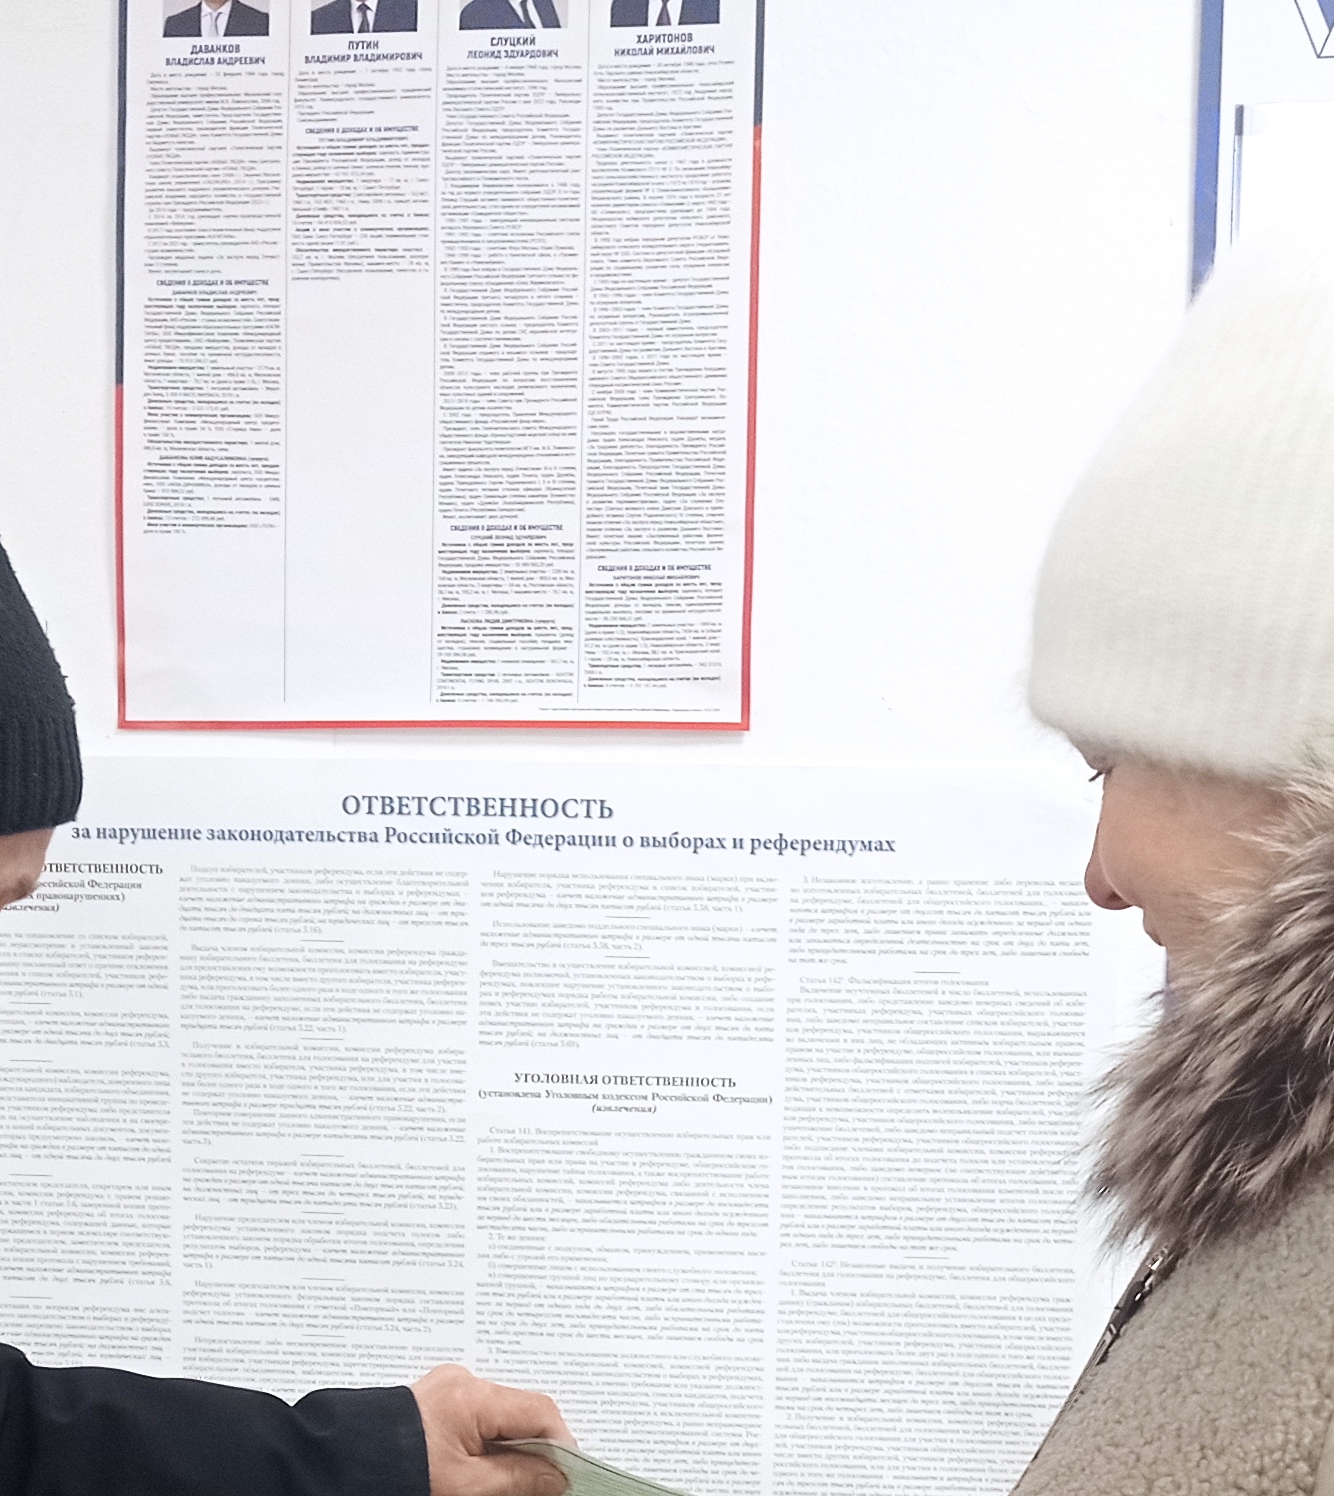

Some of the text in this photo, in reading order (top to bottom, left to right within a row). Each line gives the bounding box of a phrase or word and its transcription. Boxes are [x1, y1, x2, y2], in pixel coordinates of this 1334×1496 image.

[490, 36, 536, 48] СЛУЦКИЙ
[636, 32, 694, 44] ХАРИТОНОВ
[190, 44, 241, 56] ДАВАНКОВ
[347, 40, 379, 51] ПУТИН
[614, 45, 715, 57] НИКОЛАЙ МИХАЙЛОВИЧ
[304, 52, 423, 65] ВЛАДИМИР ВЛАДИМИРОВИЧ
[466, 49, 559, 60] ЛЕОНИД ЭДУАРДОВИЧ
[165, 56, 266, 67] ВЛАДИСЛАВ АНДРЕЕВИЧ
[342, 794, 614, 819] ОТВЕТСТВЕННОСТЬ
[71, 826, 896, 857] за нарушение законодательства Российской Федерации о выборах и референдумах
[35, 878, 142, 891] оссийской Федерации
[35, 892, 126, 903] правонарушениях)
[514, 1072, 737, 1088] УГОЛОВНАЯ ОТВЕТСТВЕННОСТЬ
[477, 1089, 773, 1105] (установлена Уголовным кодексом Российской Федерации)
[591, 1103, 657, 1114] (извлечения)
